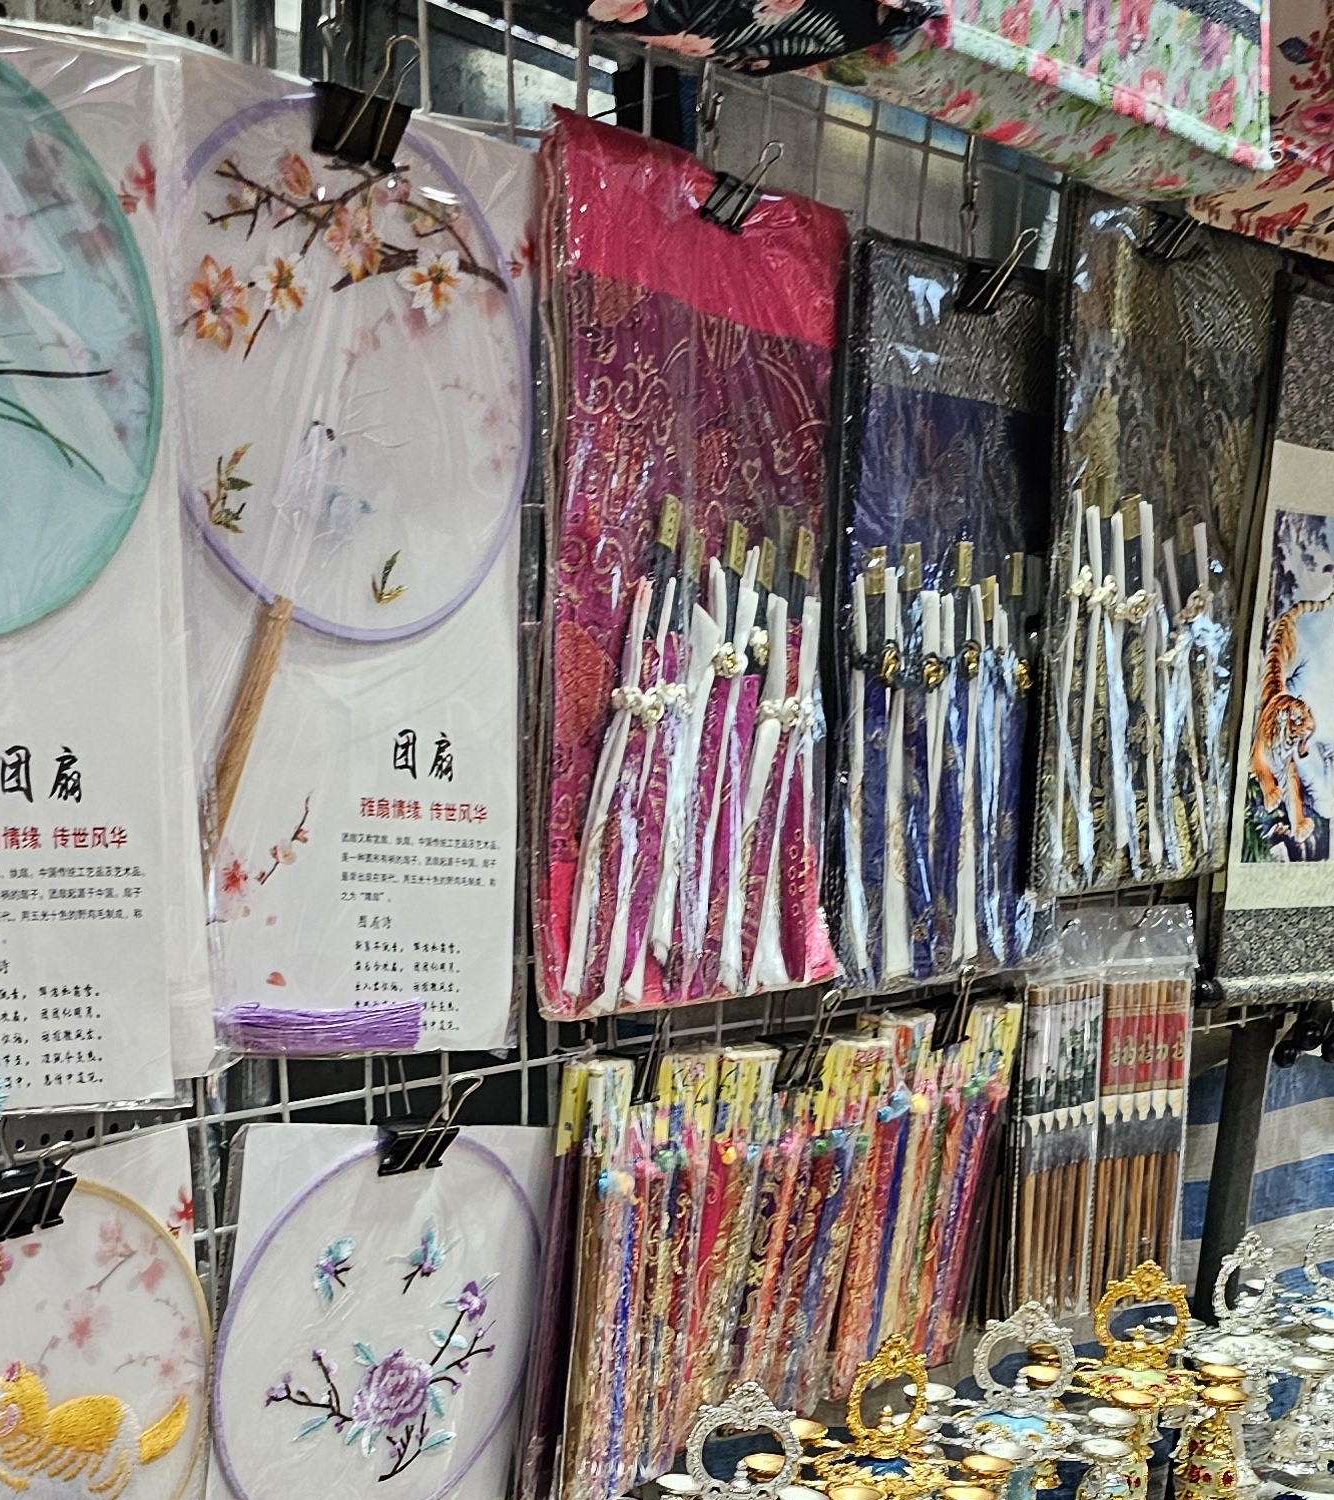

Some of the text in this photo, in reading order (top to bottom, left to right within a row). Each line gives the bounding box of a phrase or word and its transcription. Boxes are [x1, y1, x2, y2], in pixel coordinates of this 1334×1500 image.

[0, 745, 82, 803] 团扇
[393, 728, 454, 782] 团扇
[360, 797, 489, 824] 雅扇情缘 传世风华
[52, 826, 128, 849] 传世风华
